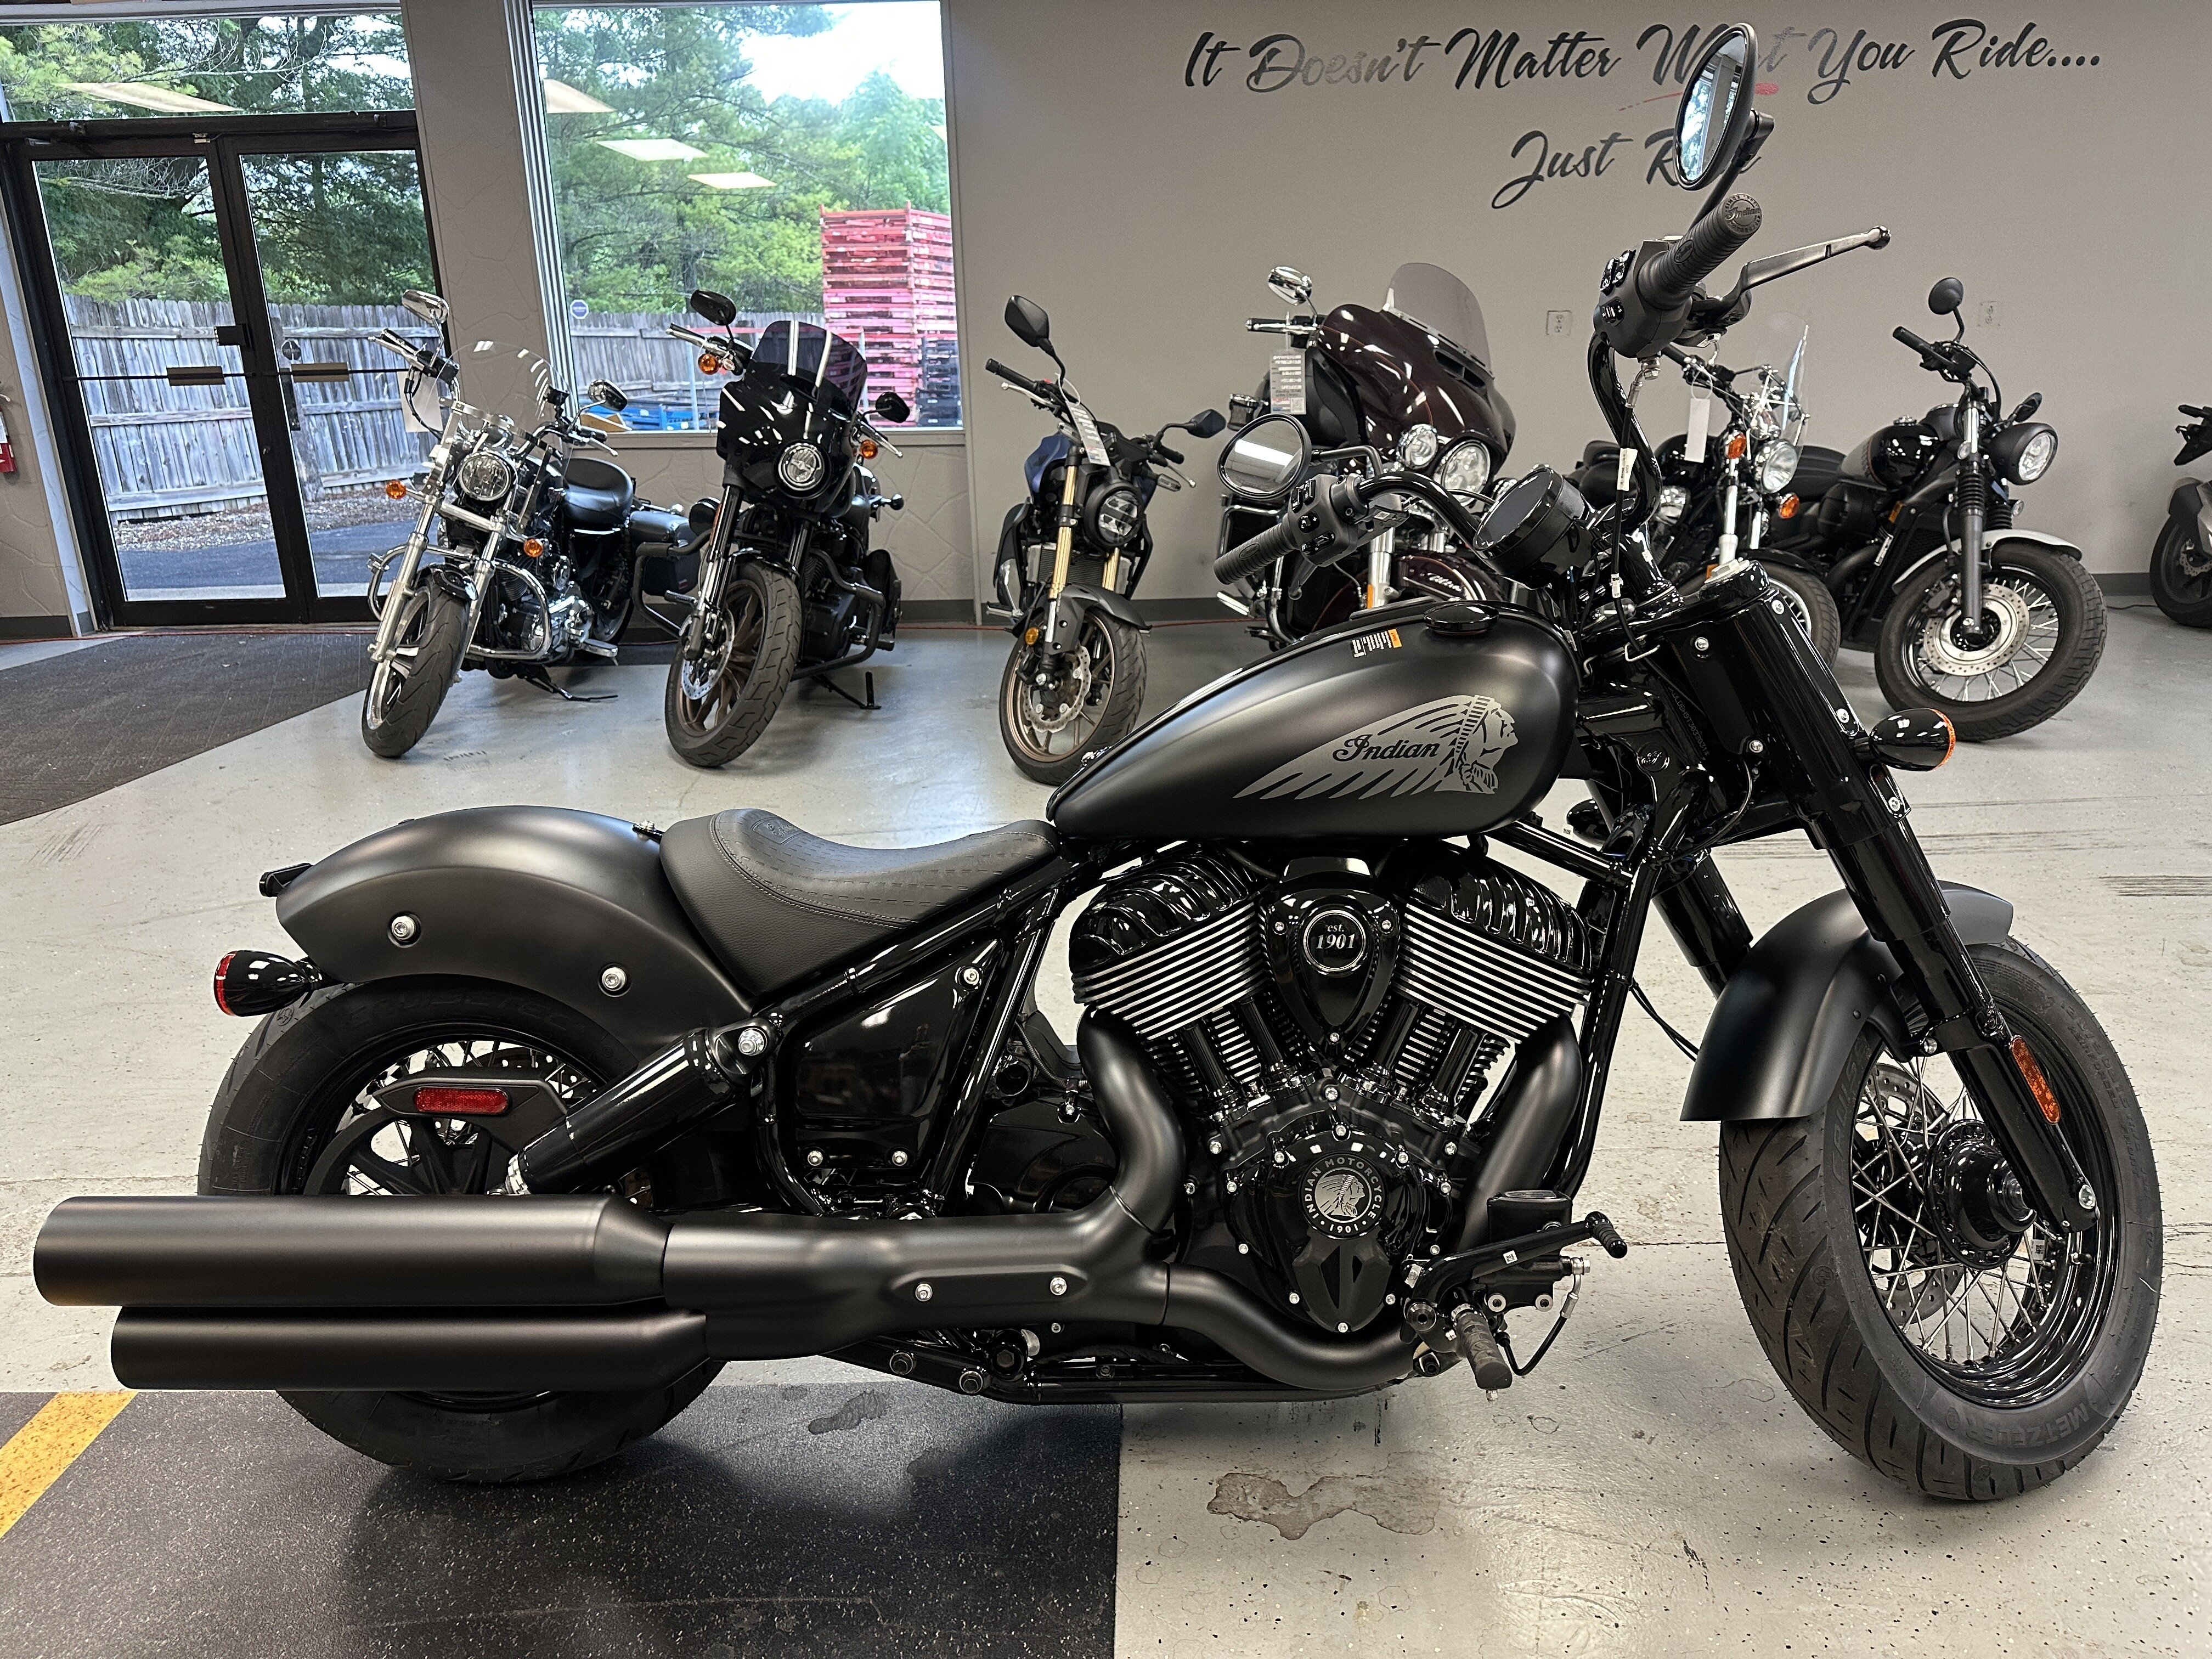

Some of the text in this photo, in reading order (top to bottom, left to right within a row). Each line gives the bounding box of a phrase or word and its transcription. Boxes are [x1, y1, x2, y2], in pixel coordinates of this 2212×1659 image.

[1184, 31, 1241, 87] It
[1246, 33, 1442, 93] Doesn't
[1444, 27, 1622, 90] Matter
[1636, 23, 1805, 86] Wt
[1807, 26, 1915, 105] You
[1491, 129, 1633, 210] Just
[1724, 206, 1760, 221] Indian
[1332, 733, 1441, 761] Indian
[1316, 934, 1356, 949] 1901
[1327, 923, 1345, 932] est.
[1304, 1156, 1383, 1220] INDIAN MOTORCYCLE
[1329, 1223, 1359, 1234] 1901
[1966, 1402, 2091, 1448] METZELER
